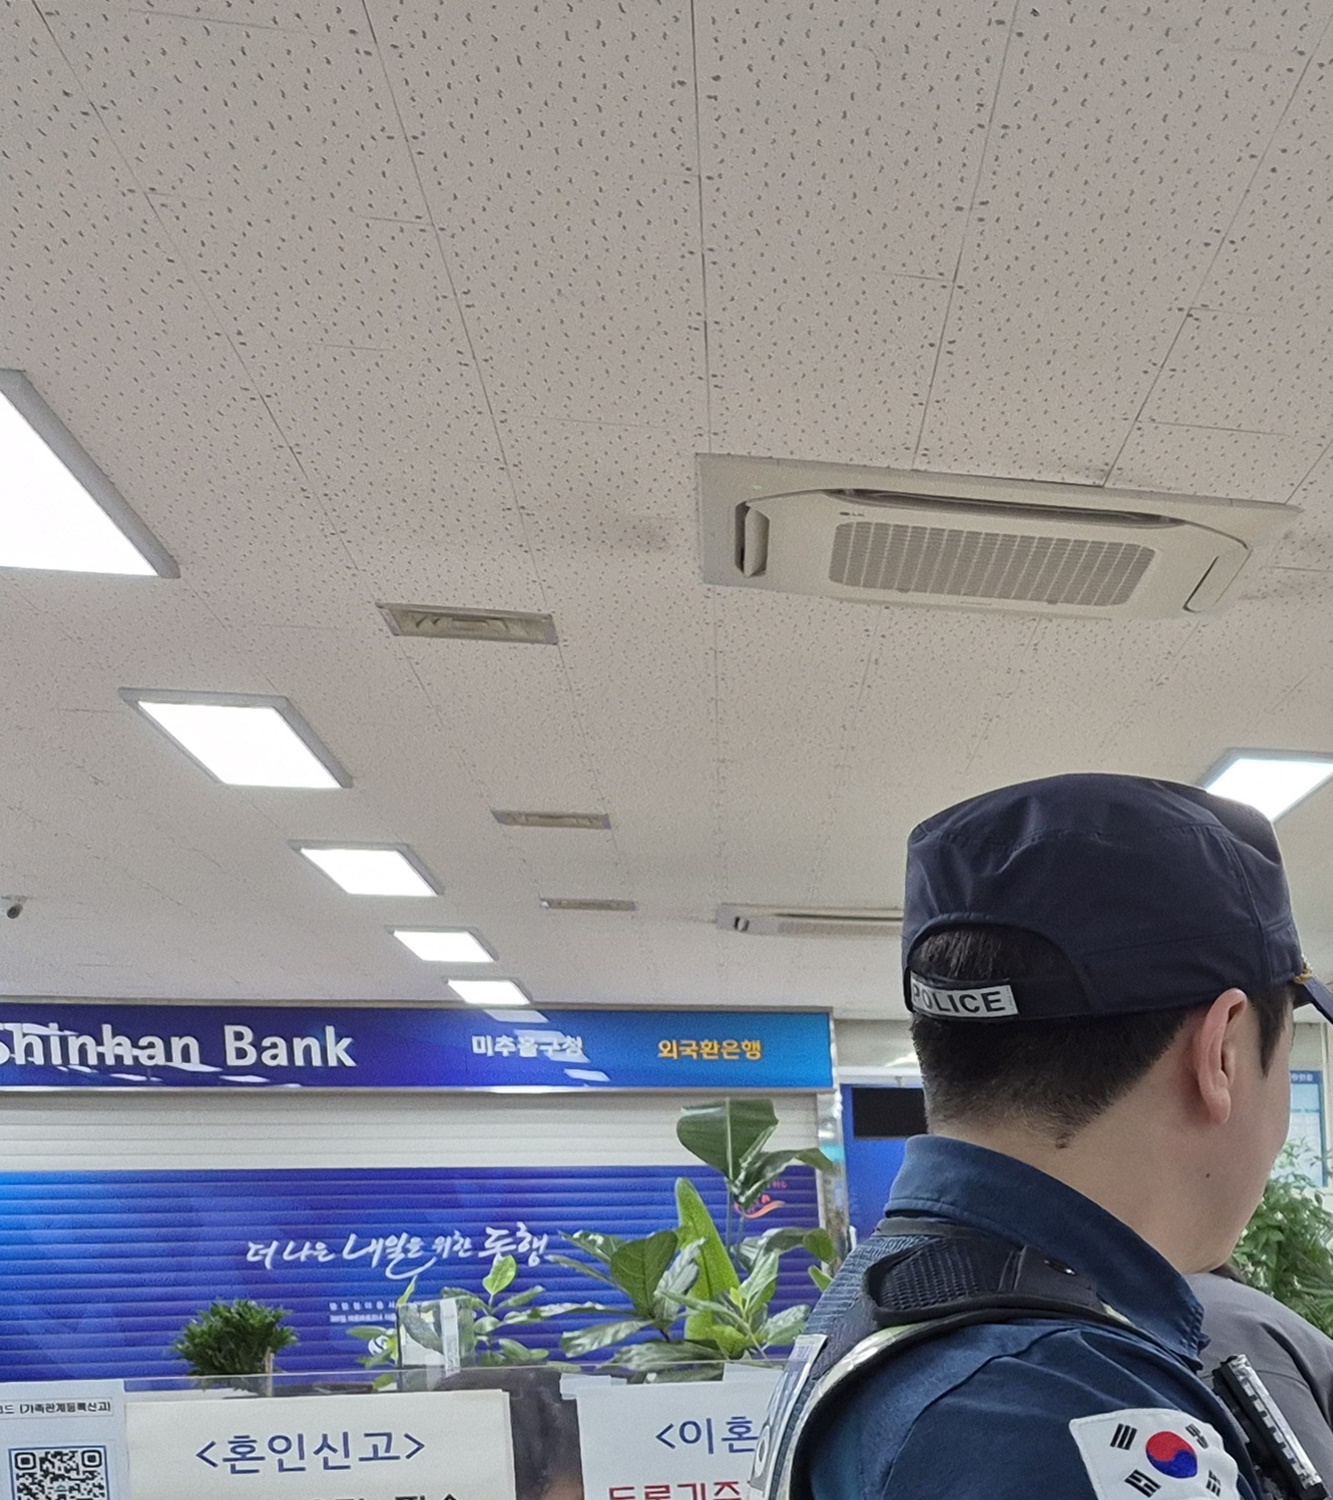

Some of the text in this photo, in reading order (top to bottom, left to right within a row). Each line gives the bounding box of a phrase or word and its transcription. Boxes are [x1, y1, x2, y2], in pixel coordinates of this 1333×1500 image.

[913, 983, 1006, 1013] POLICE
[224, 1025, 357, 1067] Bank
[657, 1040, 762, 1060] 외국환은행
[246, 1222, 549, 1280] 더 나은 내일을 위한 동행
[195, 1431, 425, 1475] <혼인신고>
